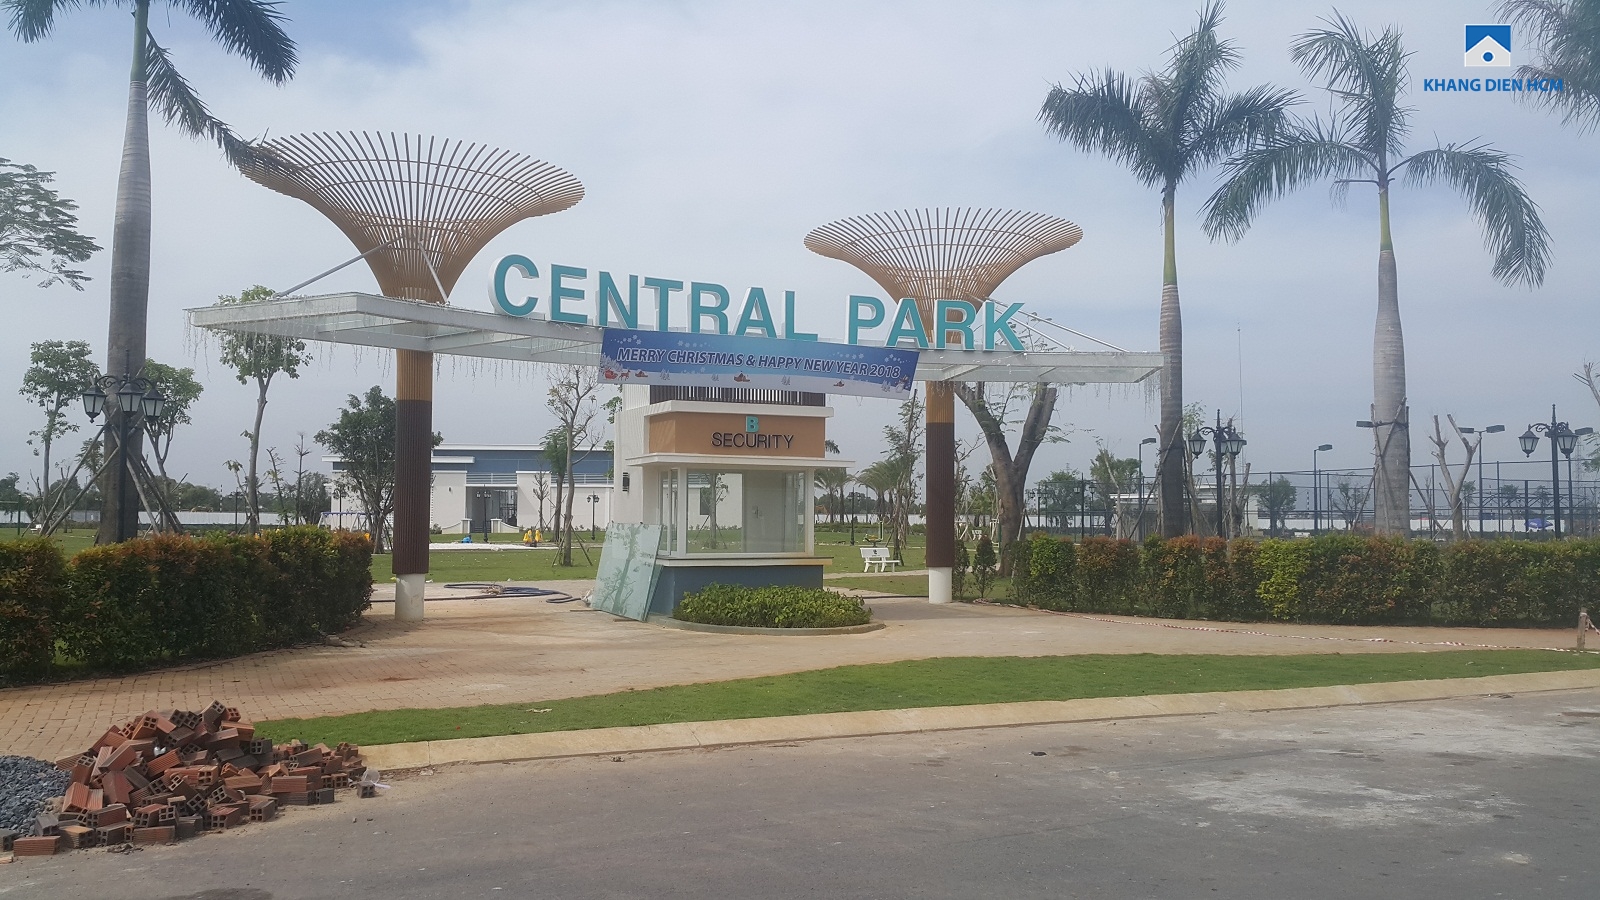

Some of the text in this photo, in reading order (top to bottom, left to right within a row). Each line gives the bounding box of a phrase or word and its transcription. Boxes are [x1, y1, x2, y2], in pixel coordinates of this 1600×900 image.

[488, 253, 1026, 351] CENTRAL PARK
[616, 347, 901, 379] MERRY CHRISTMAS & HAPPY NEW YEAR 2018
[746, 415, 759, 433] B
[711, 432, 794, 449] SECURITY
